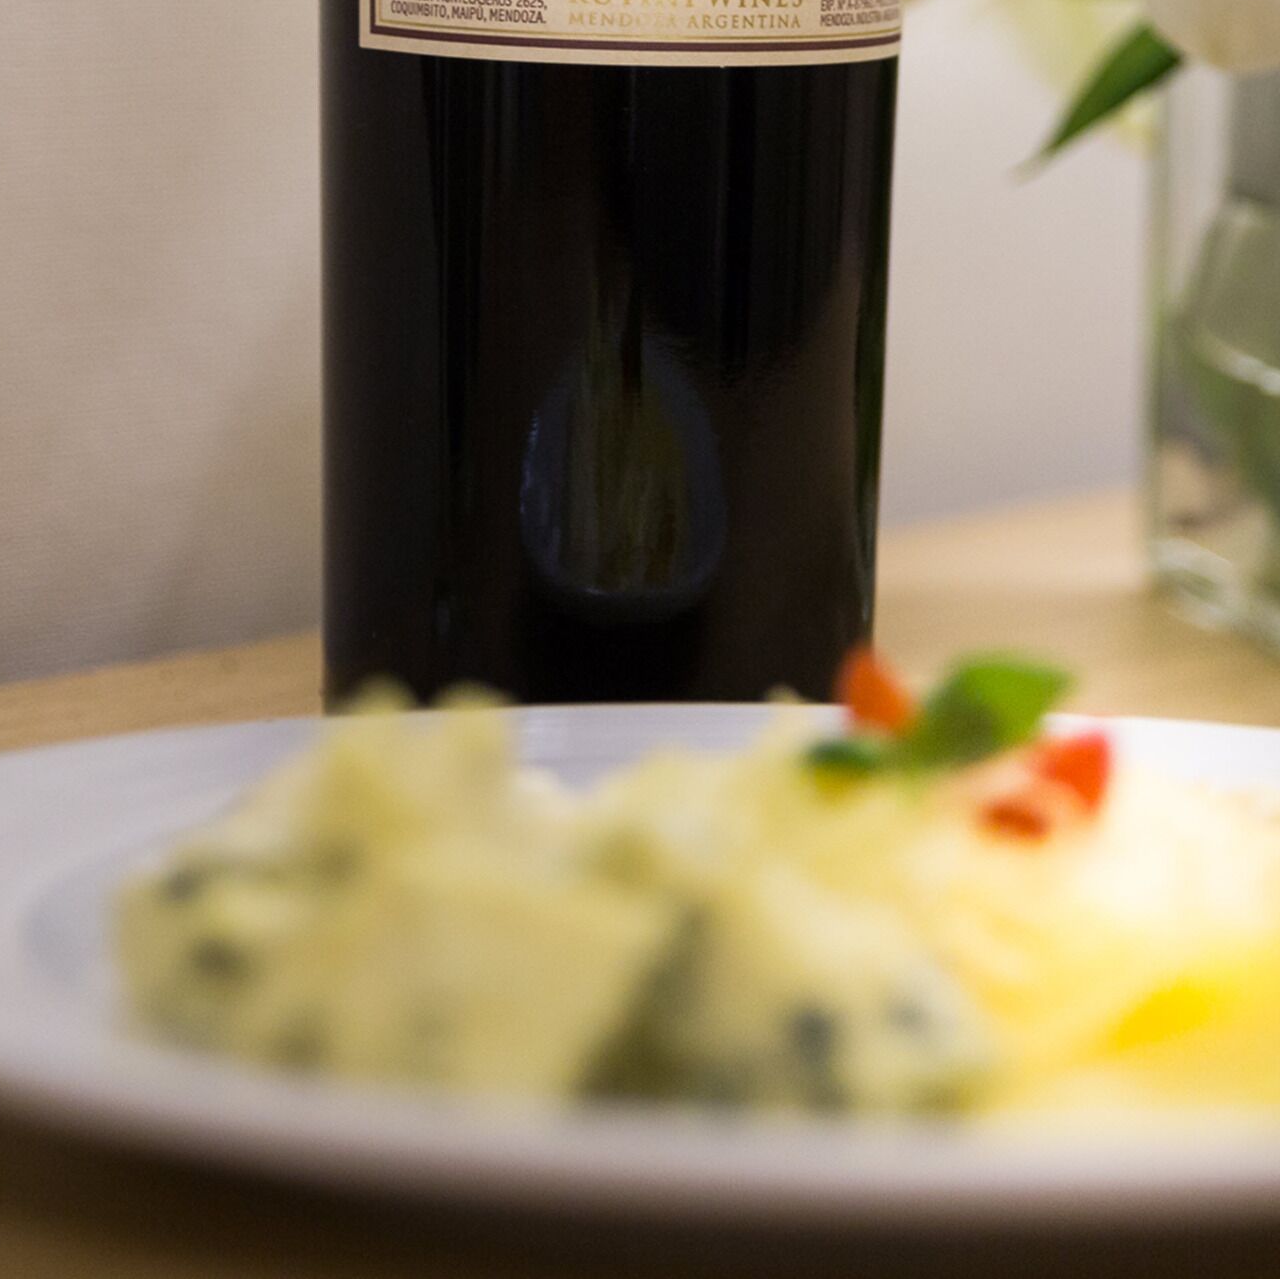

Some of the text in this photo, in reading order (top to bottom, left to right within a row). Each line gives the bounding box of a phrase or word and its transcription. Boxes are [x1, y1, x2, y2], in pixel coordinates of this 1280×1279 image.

[390, 0, 450, 21] COQUIMBITO,
[489, 8, 547, 24] MENDOZA.
[688, 13, 801, 30] ARGENTINA
